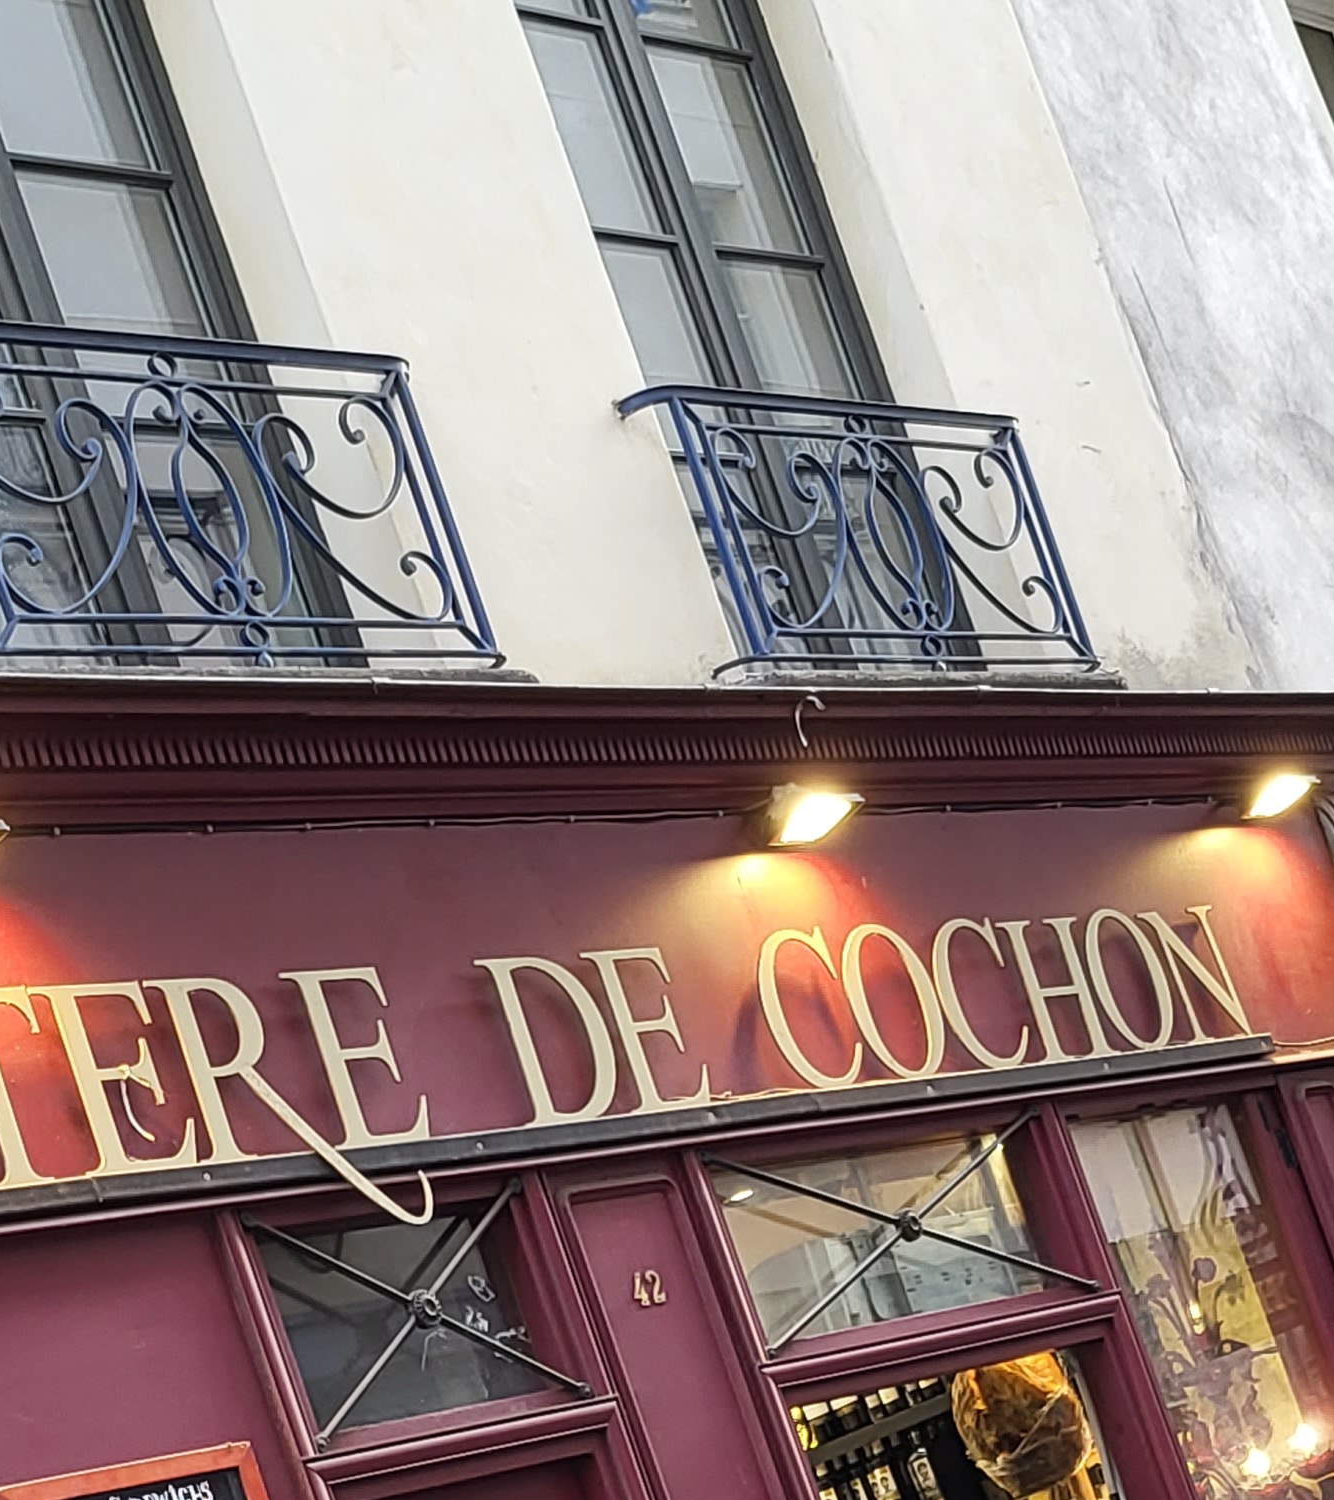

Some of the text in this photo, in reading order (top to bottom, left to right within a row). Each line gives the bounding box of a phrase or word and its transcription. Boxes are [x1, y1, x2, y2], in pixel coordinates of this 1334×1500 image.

[475, 947, 711, 1126] DE
[758, 905, 1252, 1089] COCHON
[634, 1270, 666, 1306] 42
